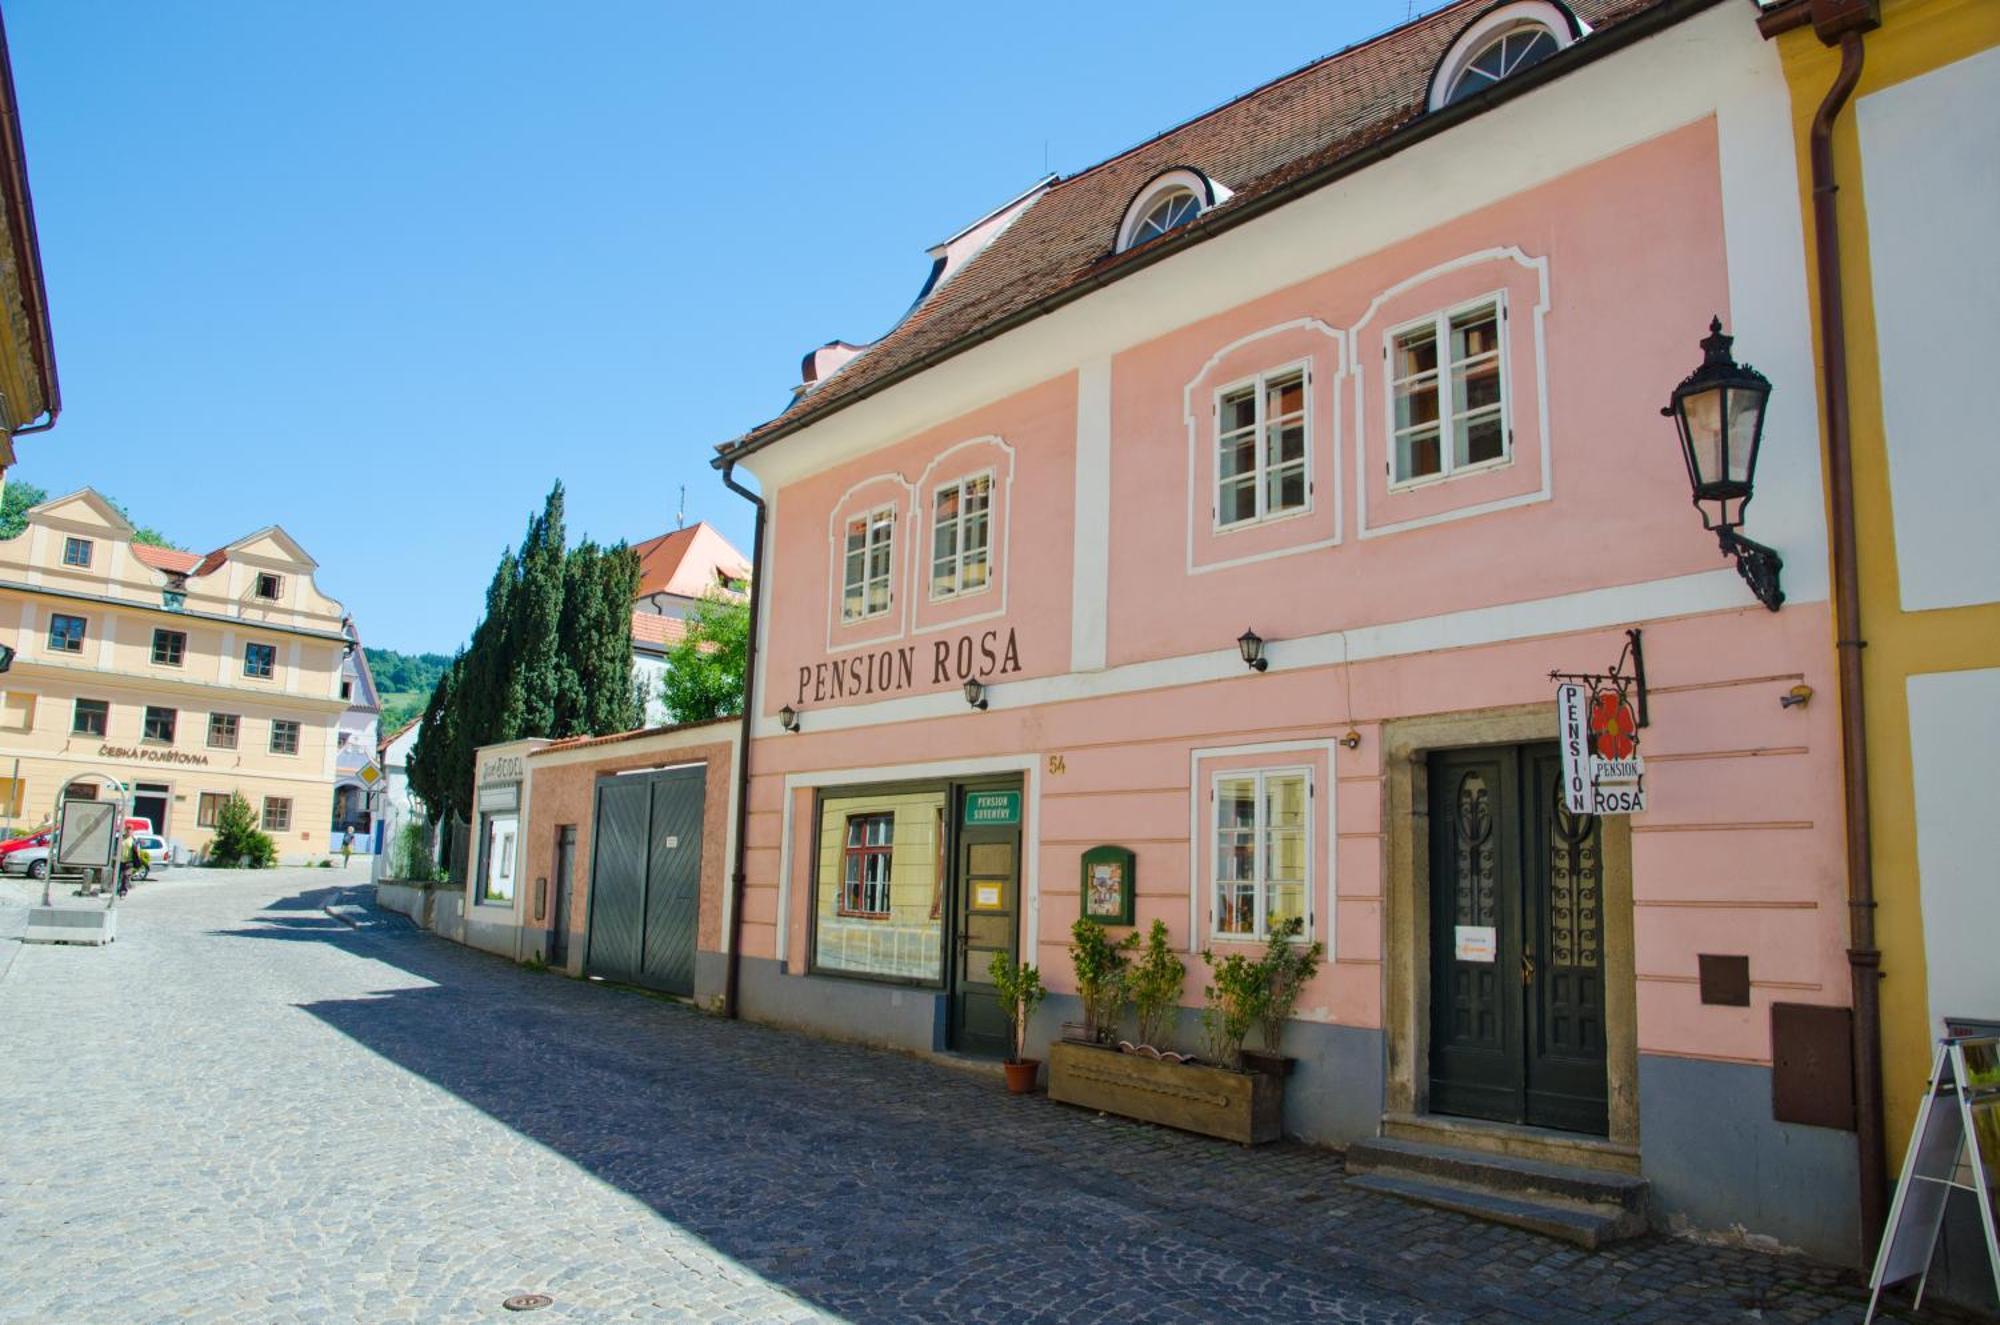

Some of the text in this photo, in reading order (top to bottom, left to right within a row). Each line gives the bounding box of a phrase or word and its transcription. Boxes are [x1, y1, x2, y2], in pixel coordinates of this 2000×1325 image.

[796, 627, 1022, 704] PENSION ROSA
[1566, 687, 1584, 812] PENSION
[1049, 755, 1066, 775] 54
[1597, 760, 1639, 778] PENSION
[977, 796, 1008, 808] PENSION
[1594, 792, 1643, 813] ROSA
